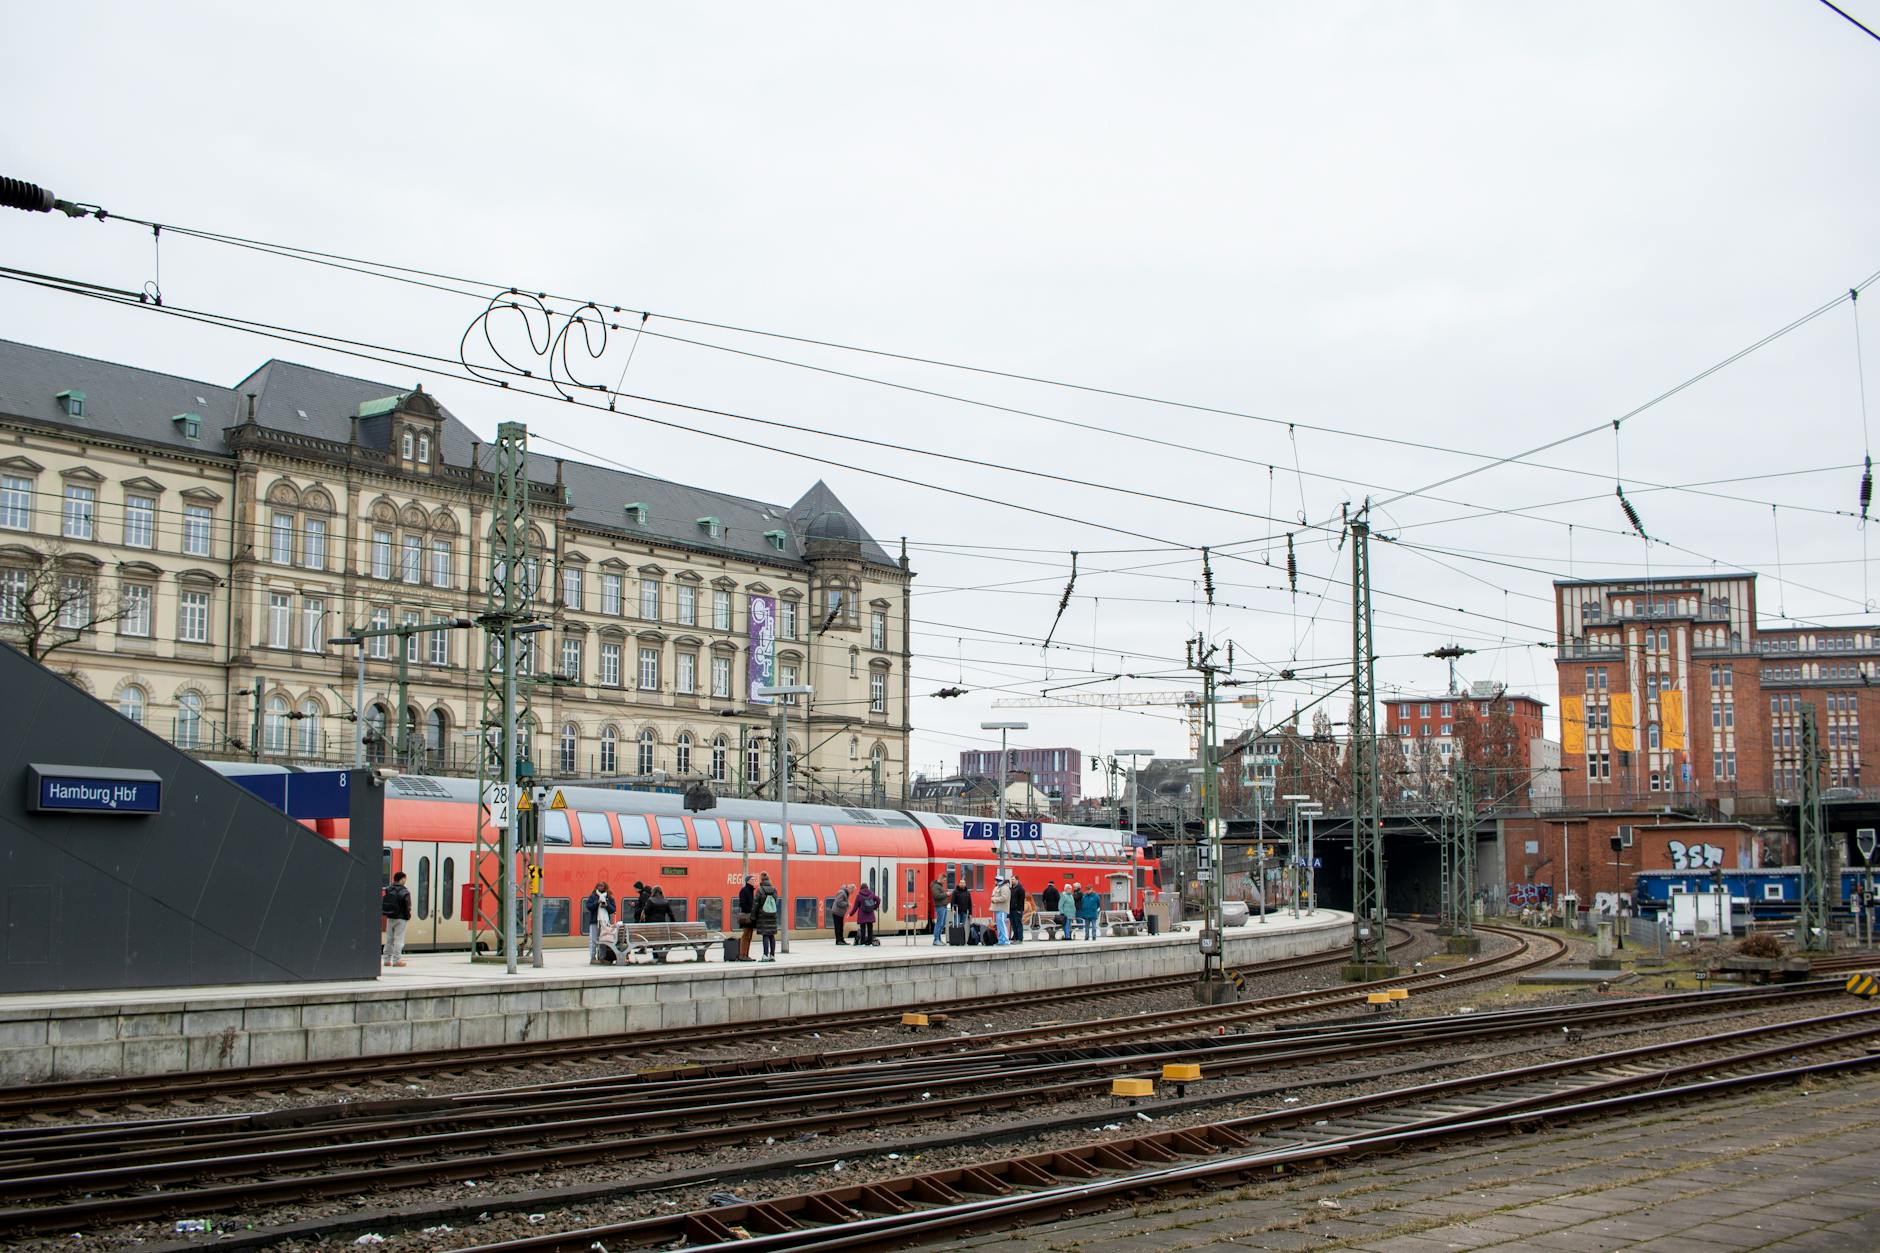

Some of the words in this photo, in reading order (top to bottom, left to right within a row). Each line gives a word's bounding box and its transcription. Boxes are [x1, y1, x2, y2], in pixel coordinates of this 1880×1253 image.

[339, 772, 347, 787] 8
[50, 783, 110, 804] Hamburg
[114, 786, 137, 801] Hbf
[493, 787, 507, 803] 28
[500, 806, 507, 822] 4
[965, 823, 975, 837] 7
[983, 823, 993, 838] B
[1010, 823, 1021, 838] B
[1029, 823, 1039, 838] 8
[1199, 847, 1210, 867] H
